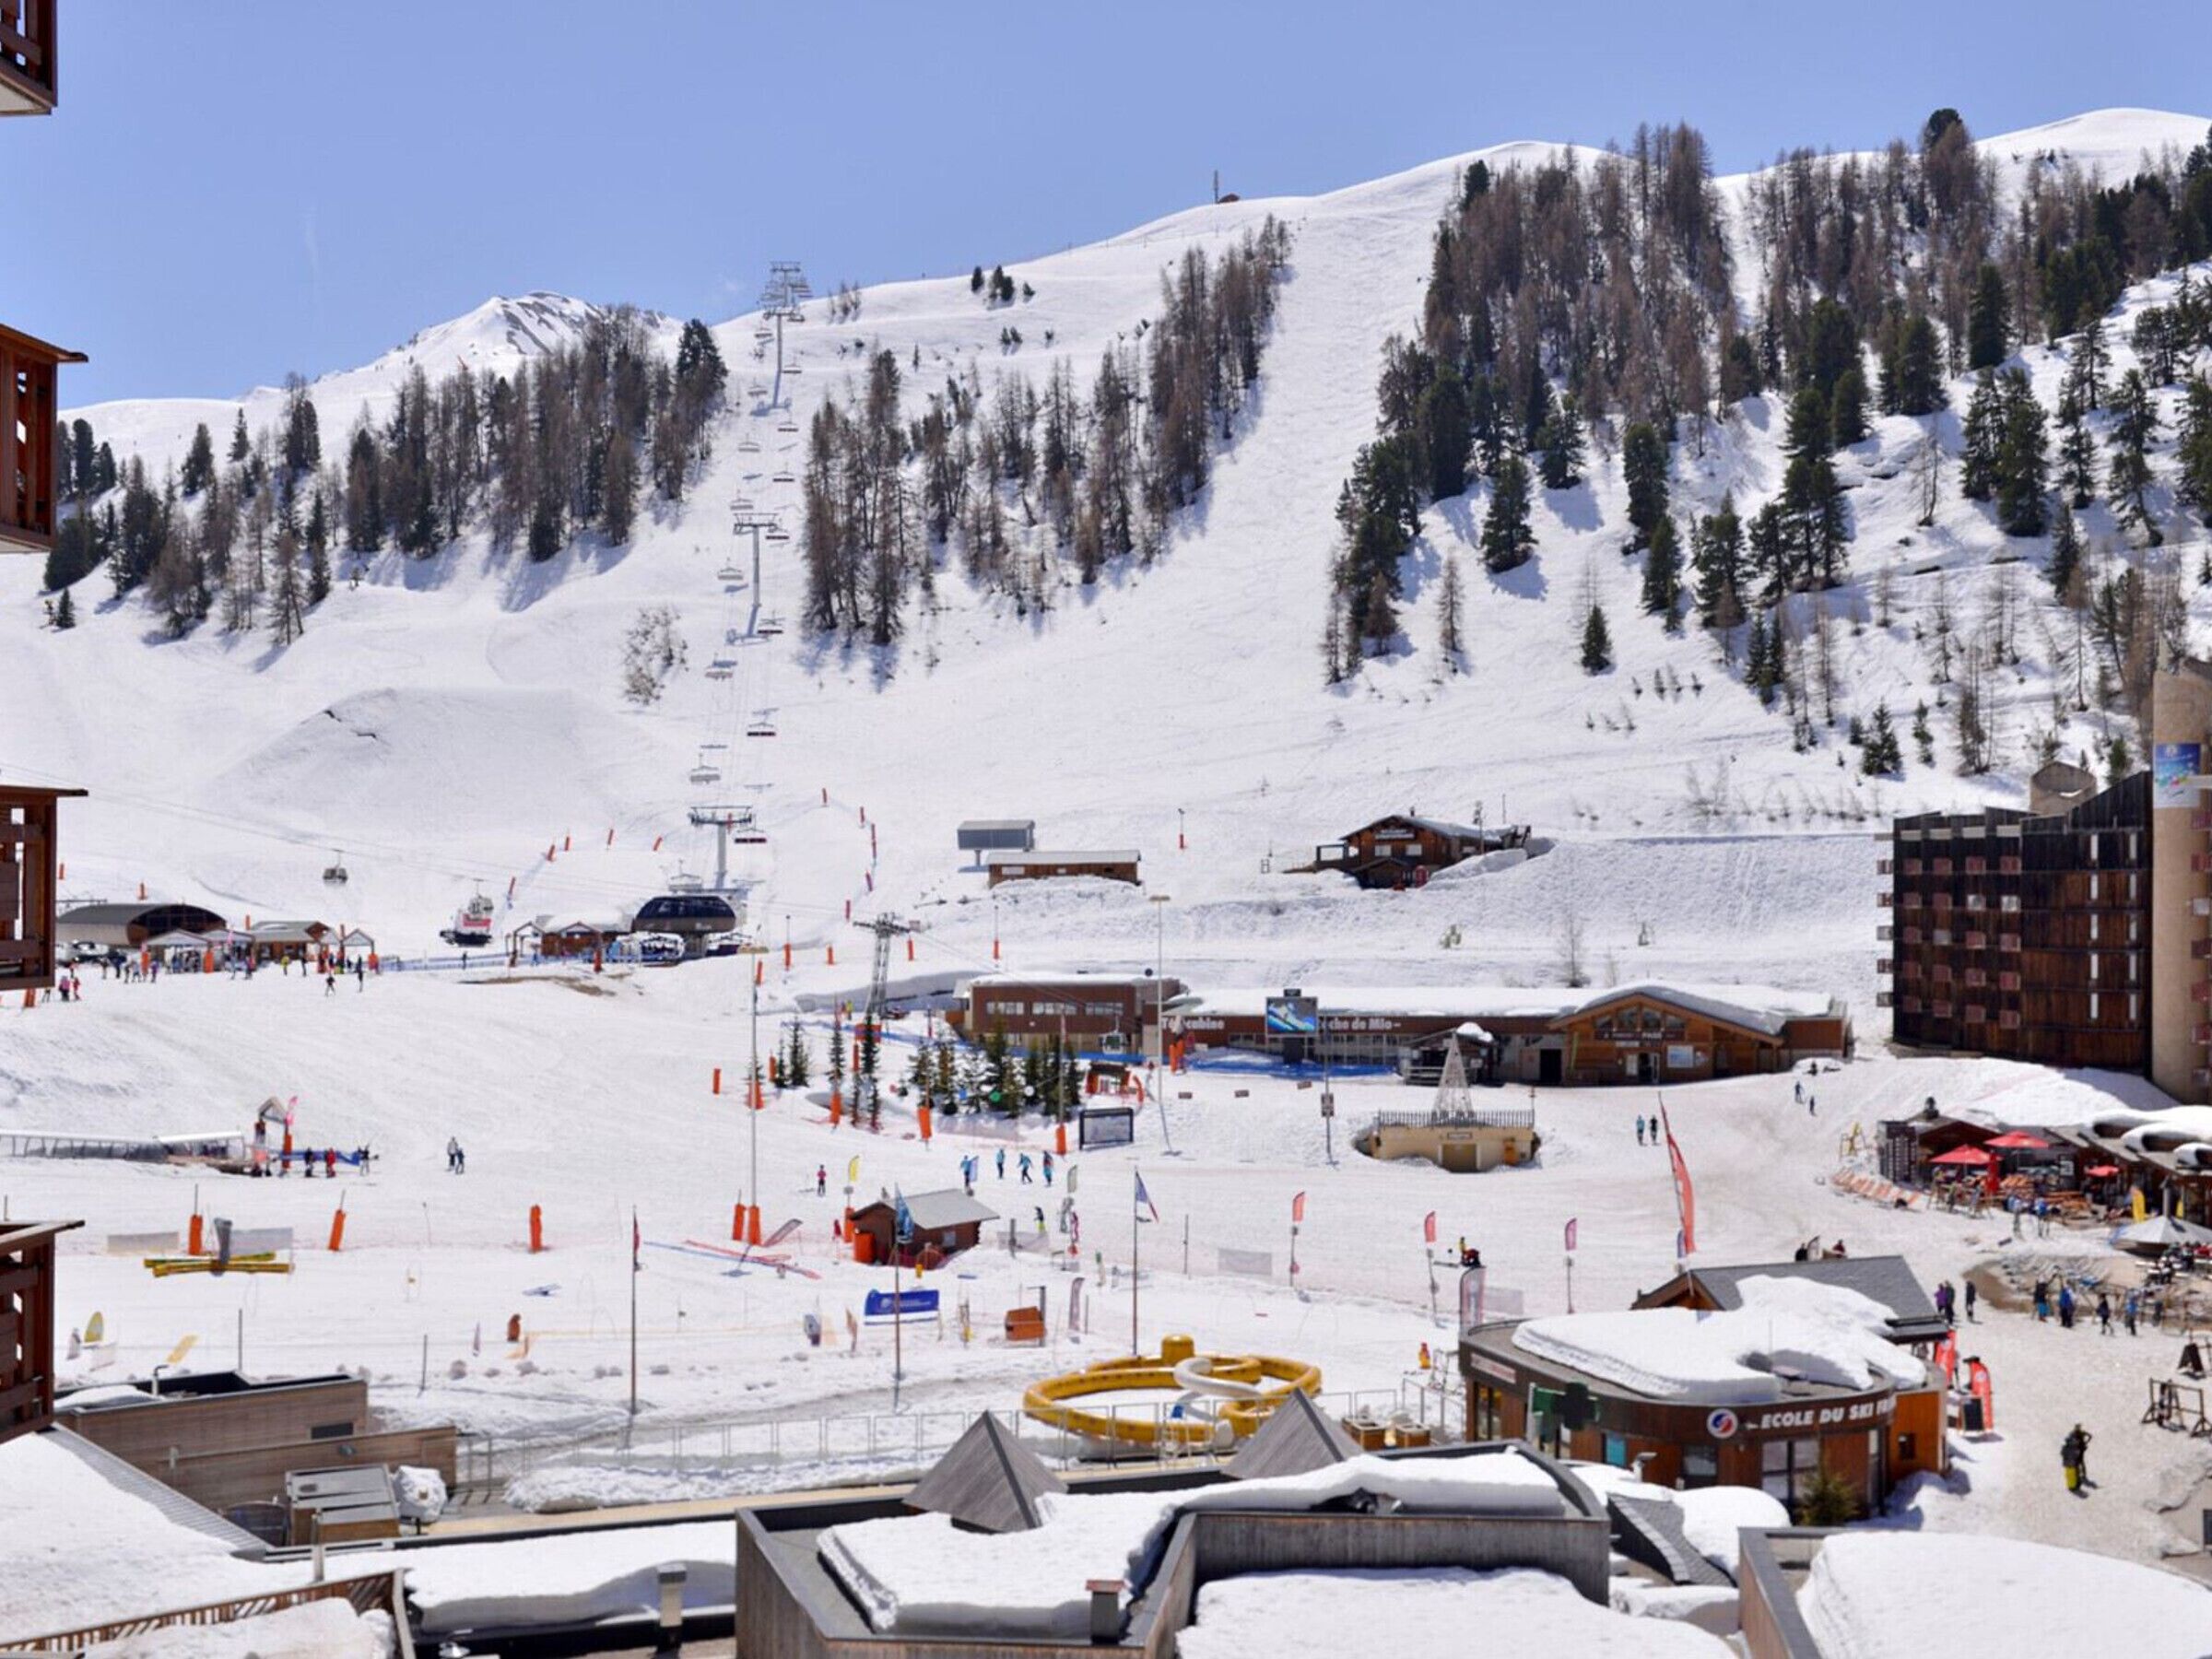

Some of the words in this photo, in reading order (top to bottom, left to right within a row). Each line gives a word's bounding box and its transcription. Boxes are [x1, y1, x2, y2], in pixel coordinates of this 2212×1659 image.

[1161, 1017, 1225, 1030] Técabine
[1761, 1410, 1815, 1429] ECOLE
[1819, 1407, 1844, 1424] DU
[1849, 1403, 1874, 1420] SKI
